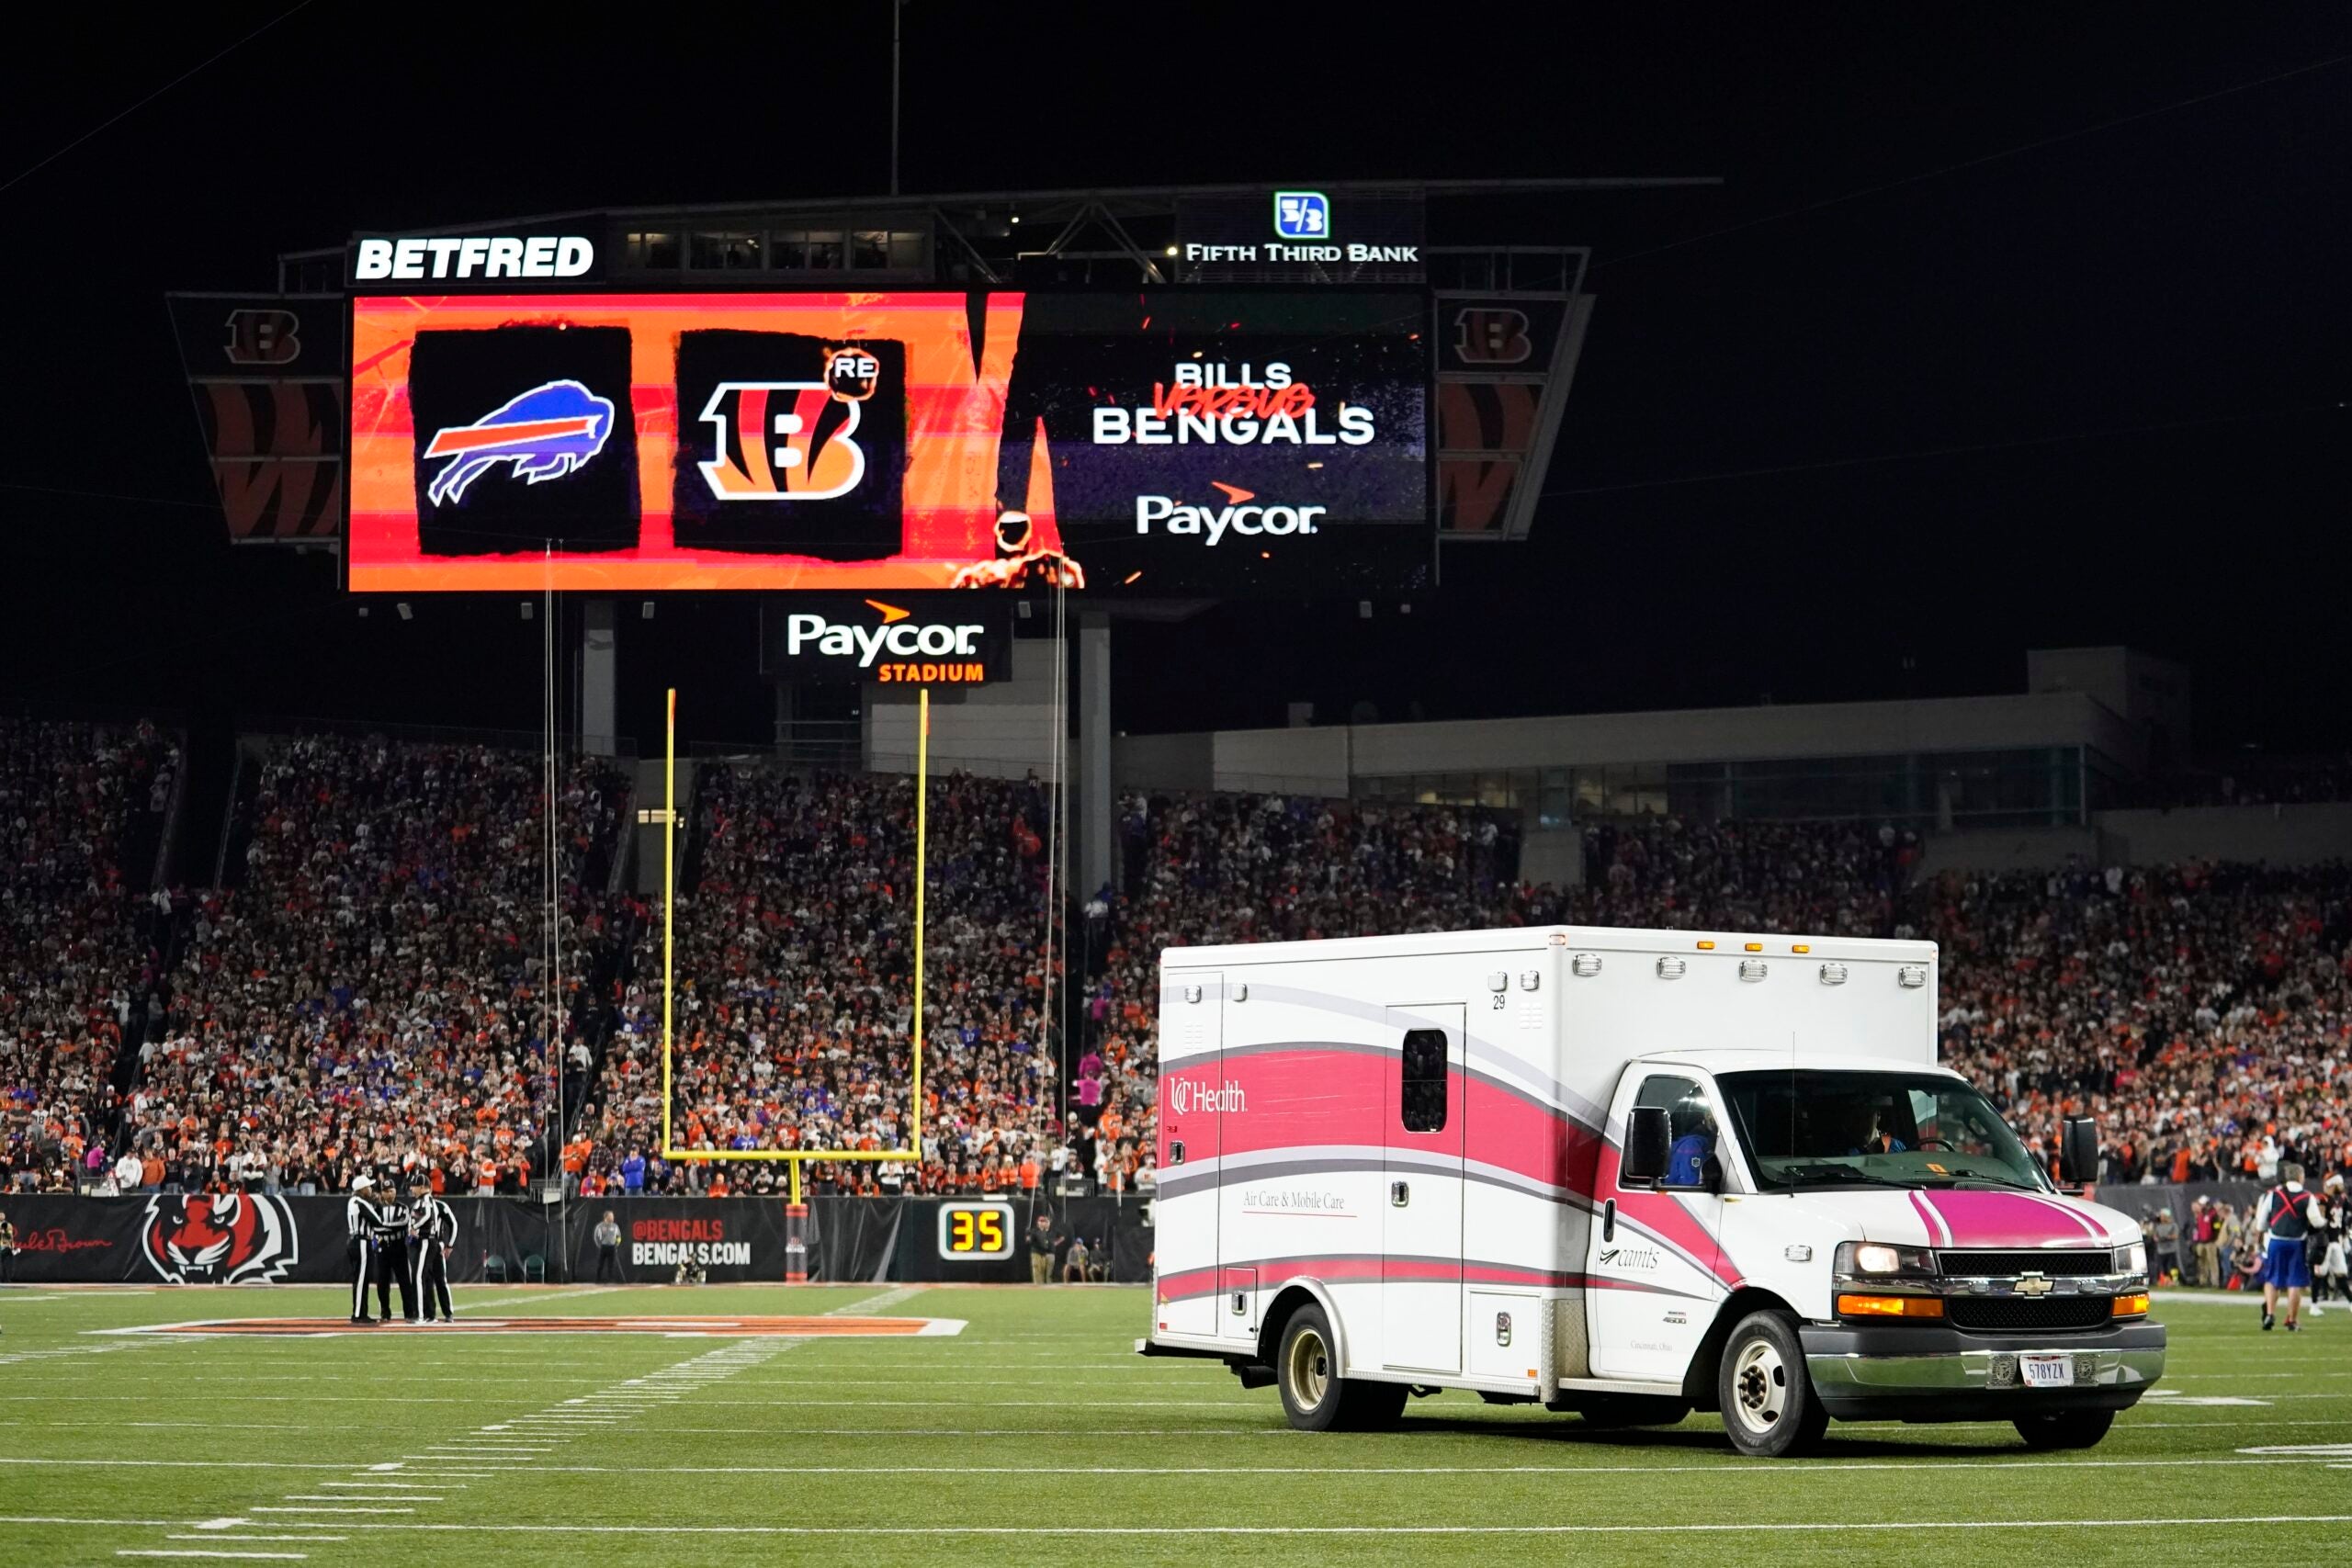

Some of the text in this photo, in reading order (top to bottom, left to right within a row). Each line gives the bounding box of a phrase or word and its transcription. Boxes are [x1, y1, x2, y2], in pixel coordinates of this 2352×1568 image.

[356, 236, 594, 279] BETFRED
[1186, 243, 1419, 263] FIFTH THIRD BANK
[1175, 363, 1292, 390] BILLS
[1093, 406, 1375, 445] BENGALS
[878, 664, 984, 682] STADIUM
[1493, 994, 1506, 1010] 29
[1244, 1190, 1344, 1210] Air Care & Mobile Care
[632, 1219, 723, 1241] @BENGALS
[953, 1211, 1002, 1251] 35
[1618, 1247, 1660, 1269] camts
[2029, 1363, 2064, 1380] 578YZX
